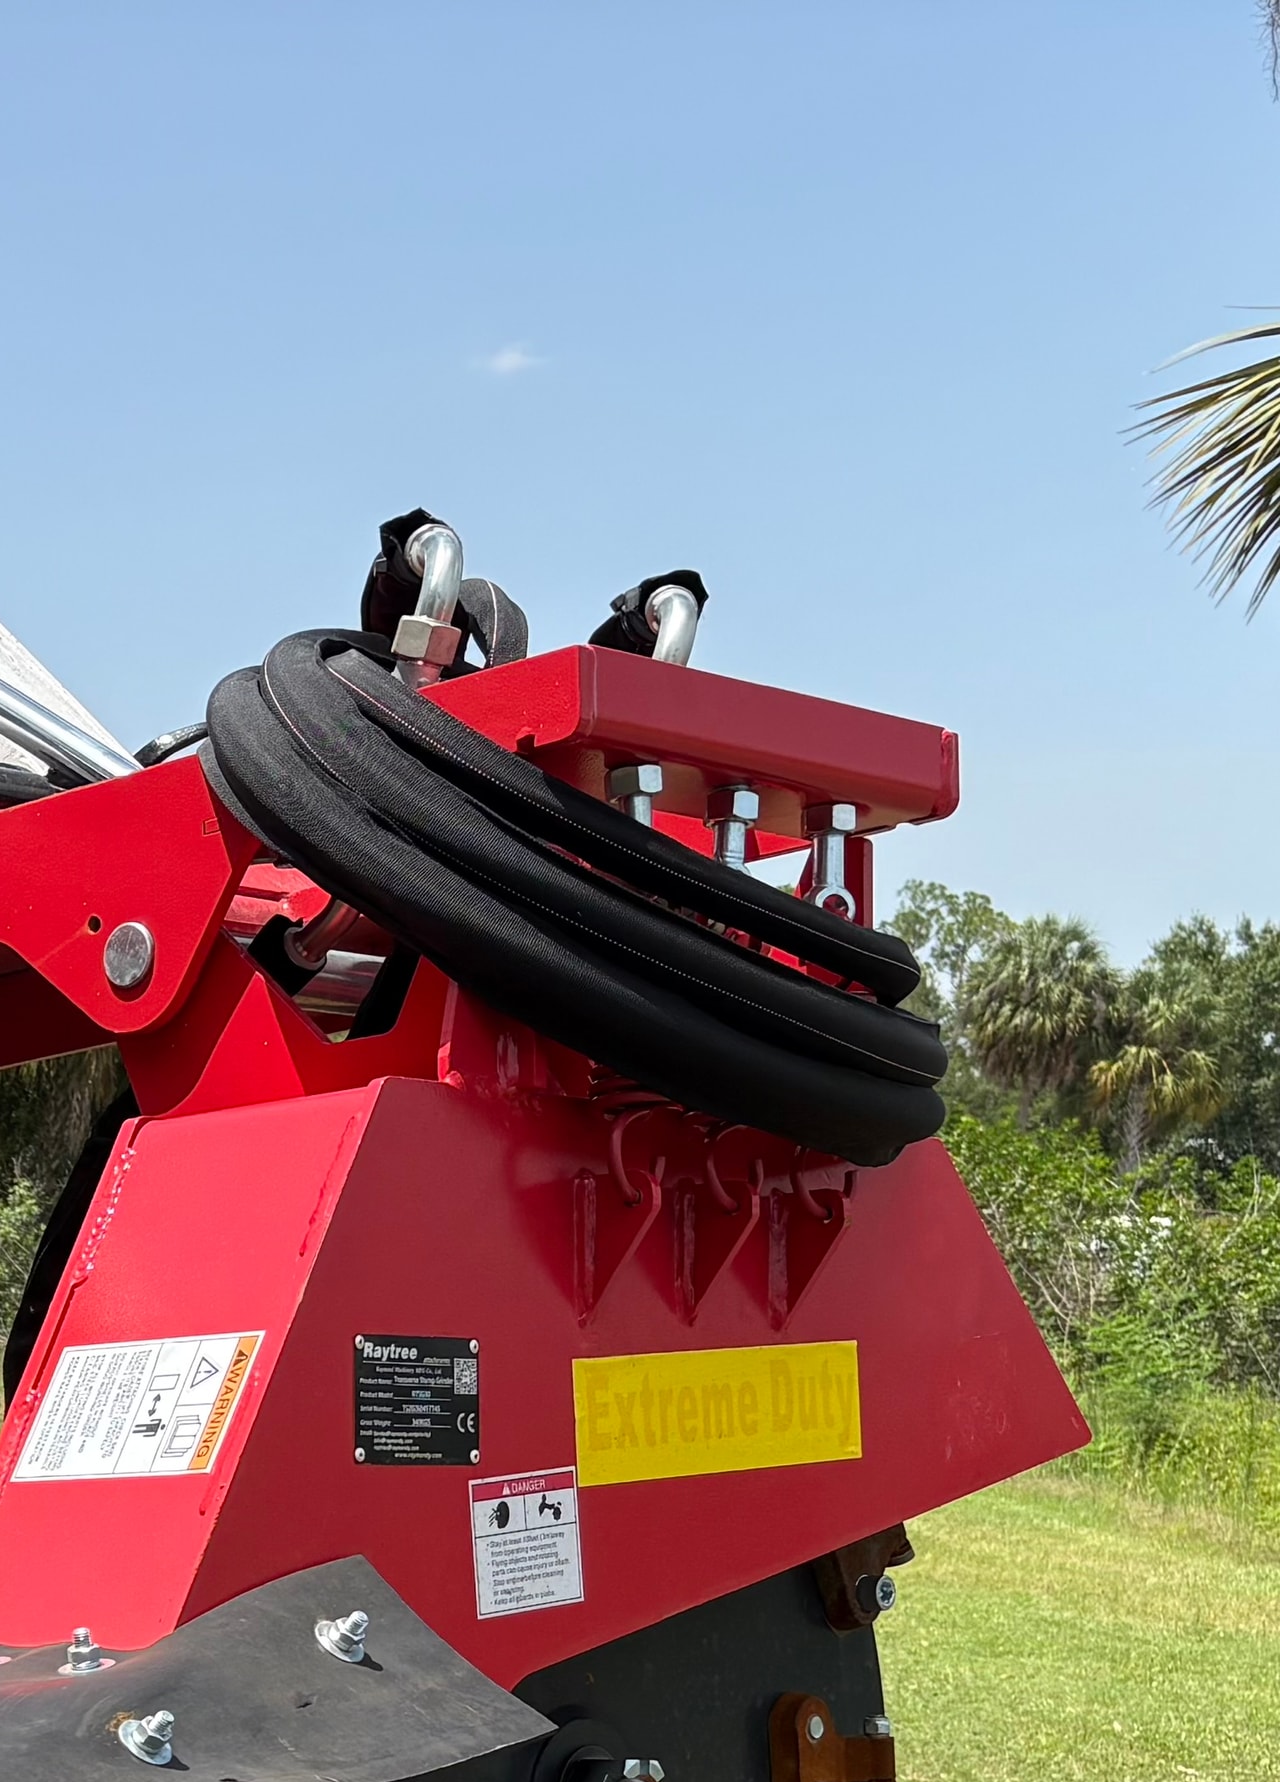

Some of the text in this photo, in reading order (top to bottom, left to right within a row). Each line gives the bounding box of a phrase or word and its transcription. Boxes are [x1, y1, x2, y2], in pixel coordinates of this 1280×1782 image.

[363, 1342, 417, 1361] Raytree
[196, 1361, 243, 1458] WARNING
[586, 1359, 855, 1451] Extreme Duty
[511, 1479, 545, 1493] DANGER
[492, 1559, 507, 1567] Flying
[492, 1569, 505, 1577] parts
[517, 1565, 532, 1573] cause
[493, 1579, 504, 1587] Stop
[542, 1570, 564, 1578] cleaning
